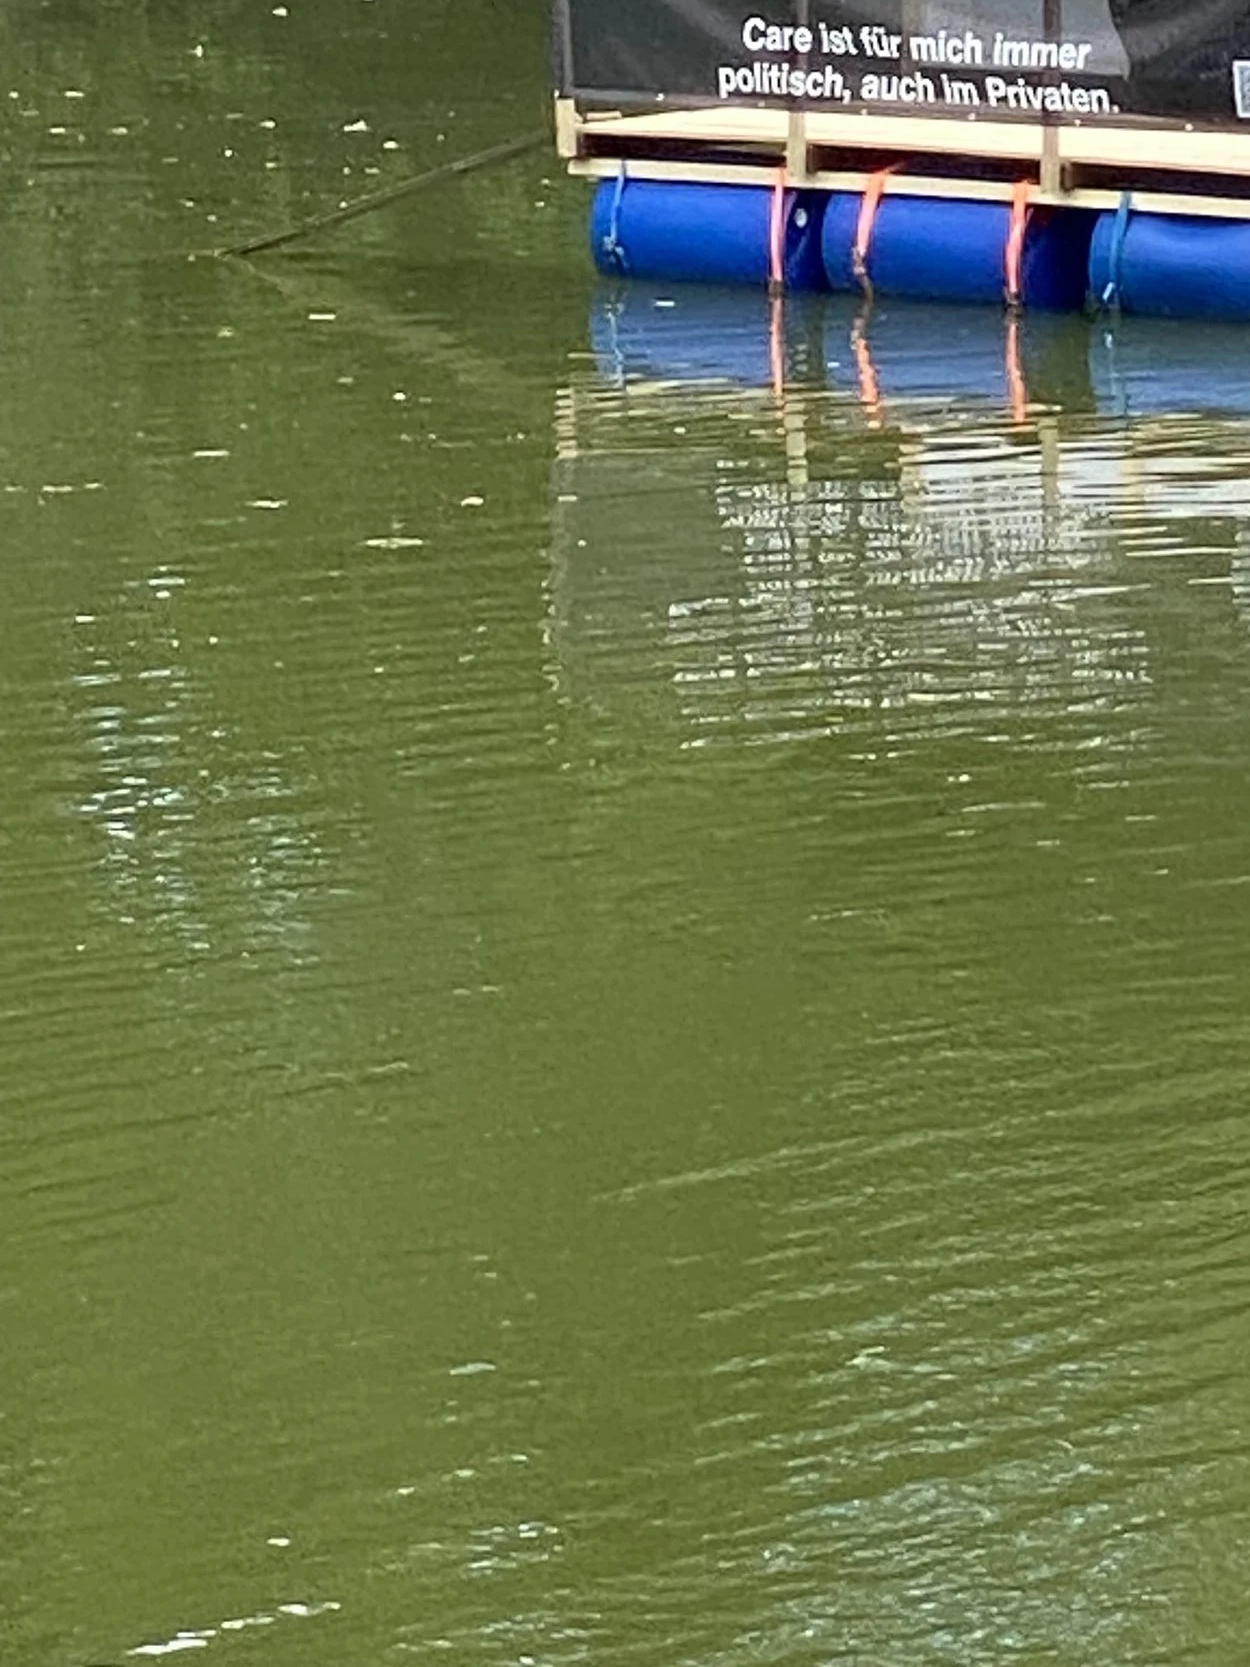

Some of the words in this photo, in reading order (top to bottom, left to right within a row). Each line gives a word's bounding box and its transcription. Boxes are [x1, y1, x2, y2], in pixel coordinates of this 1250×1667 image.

[743, 18, 812, 53] Care
[819, 23, 858, 55] ist
[860, 27, 901, 58] für
[910, 30, 984, 66] mich
[992, 31, 1093, 70] immer
[716, 62, 851, 105] politisch,
[859, 72, 936, 104] auch
[940, 74, 980, 107] im
[983, 77, 1119, 114] Privaten.
